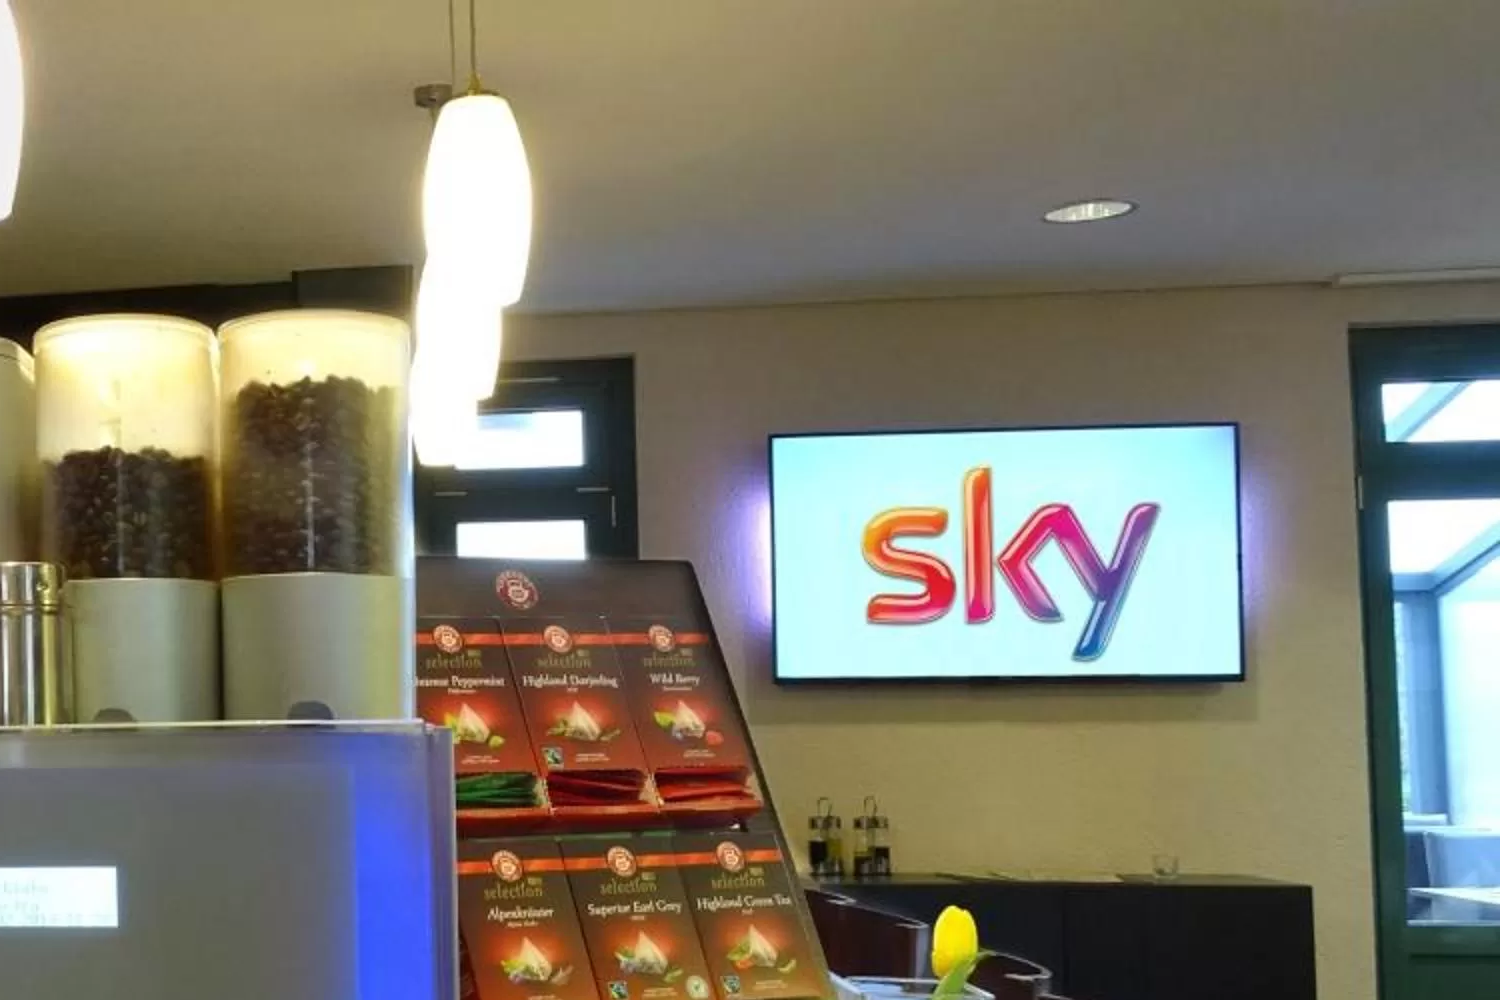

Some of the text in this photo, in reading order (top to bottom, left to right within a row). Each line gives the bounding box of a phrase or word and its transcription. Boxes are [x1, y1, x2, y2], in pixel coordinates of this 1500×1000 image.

[861, 464, 1160, 661] sky
[522, 673, 619, 689] Highland Darjeeling
[649, 672, 700, 687] Wild Berry
[484, 880, 543, 900] selection
[633, 900, 655, 913] Earl
[656, 899, 682, 915] Grey
[696, 894, 743, 913] Highland
